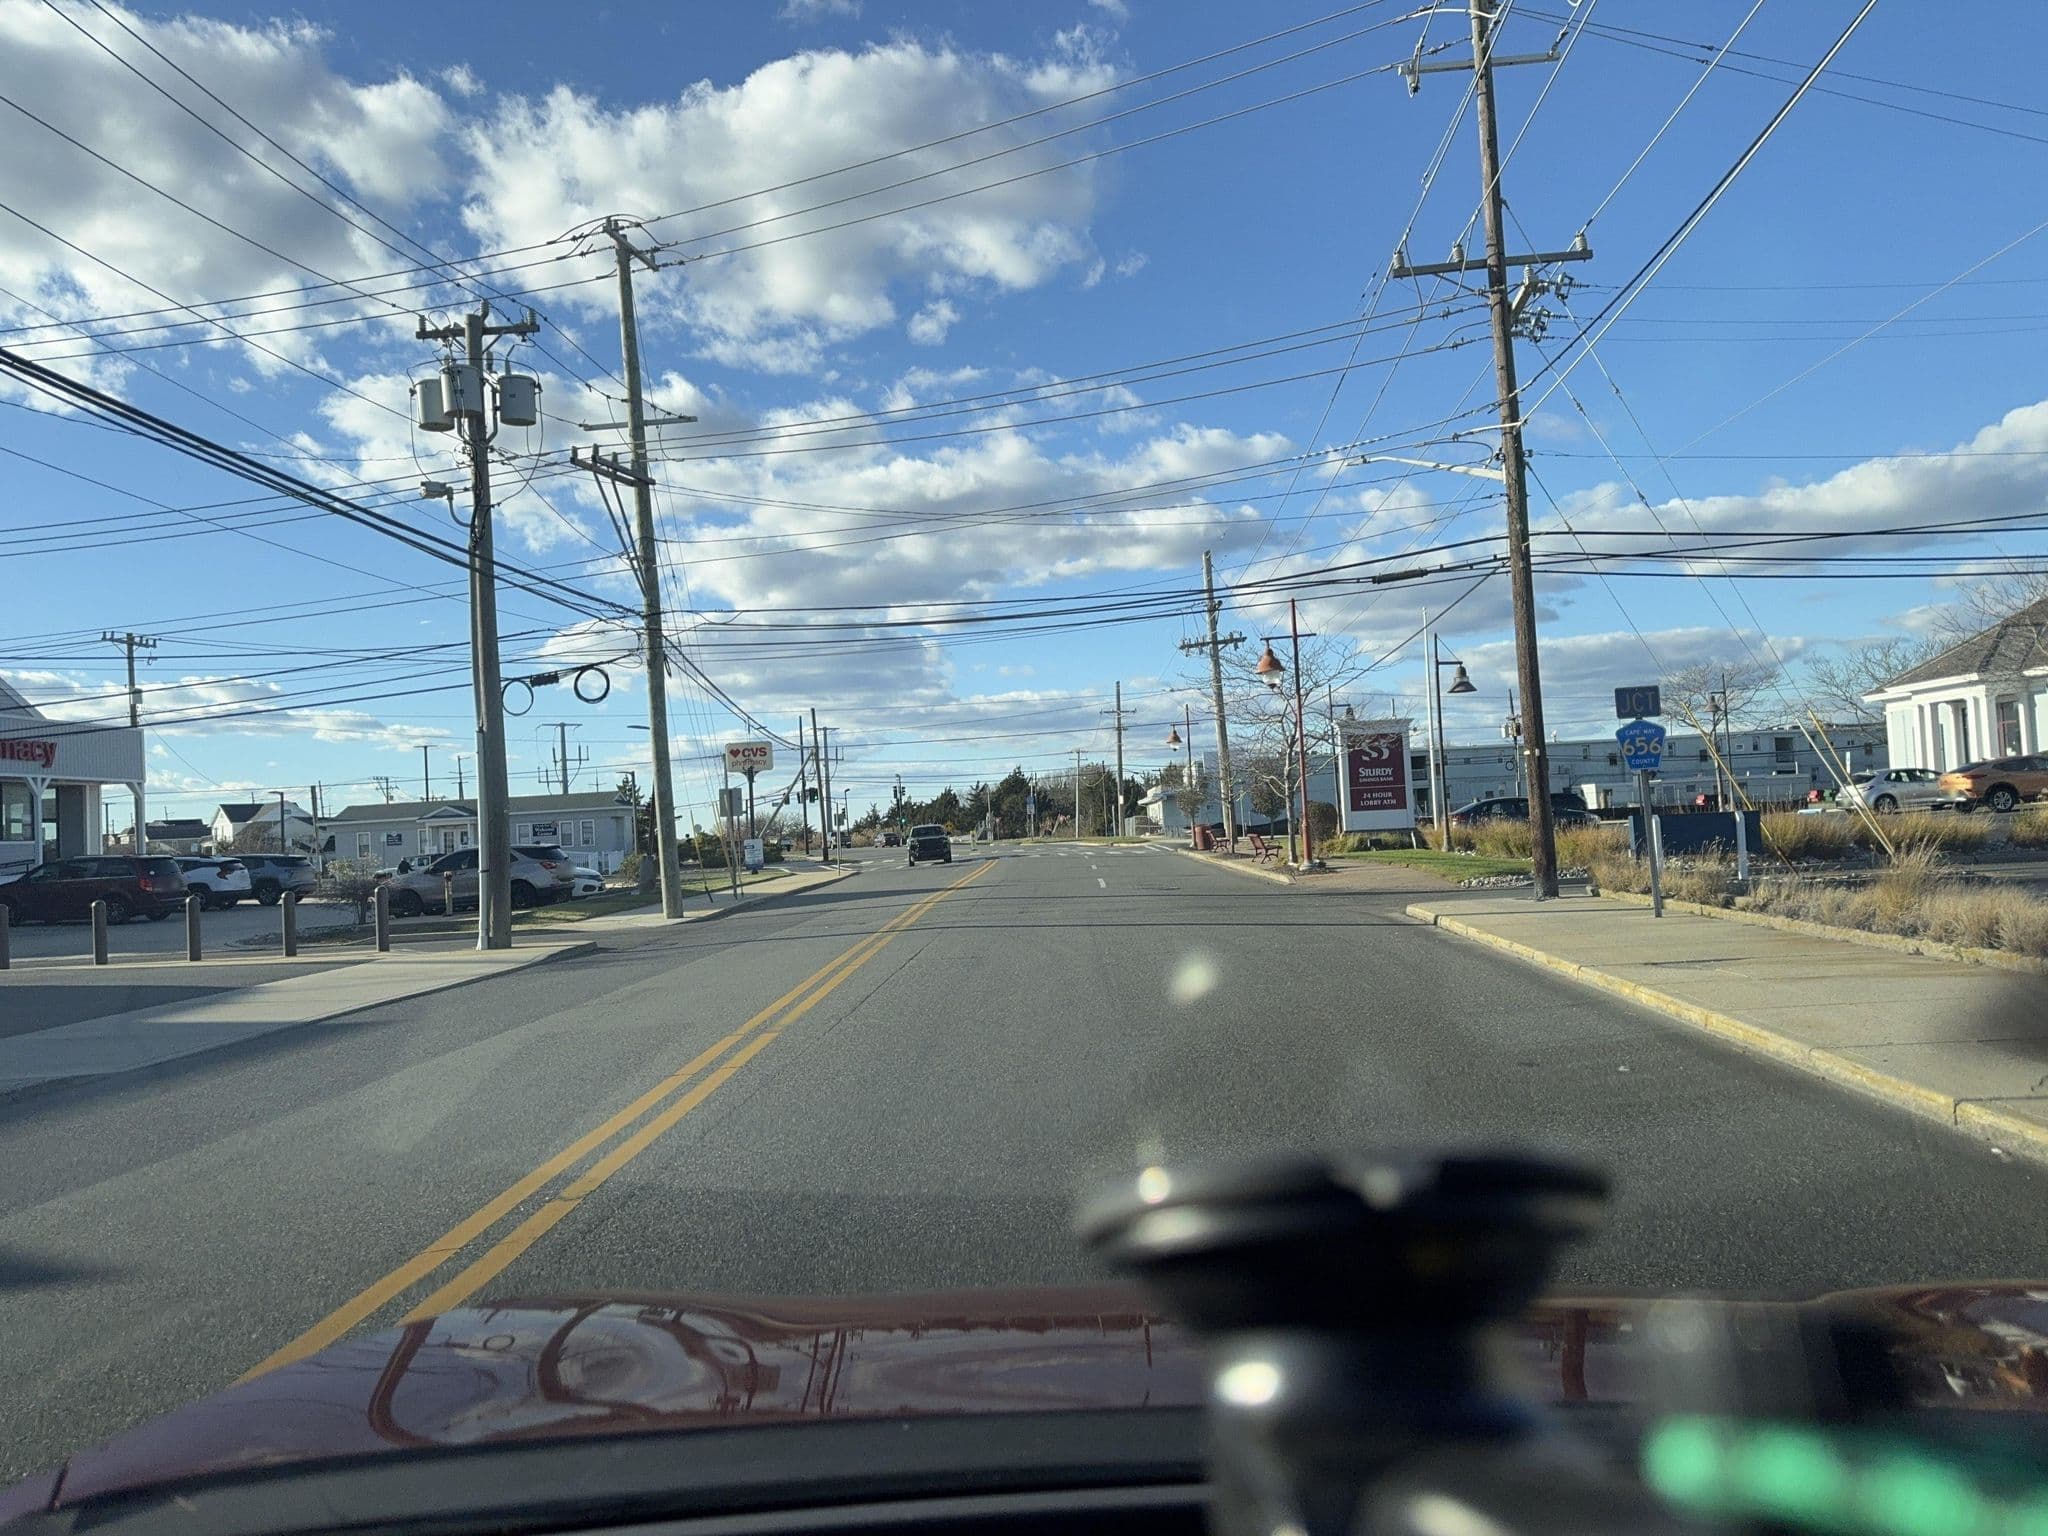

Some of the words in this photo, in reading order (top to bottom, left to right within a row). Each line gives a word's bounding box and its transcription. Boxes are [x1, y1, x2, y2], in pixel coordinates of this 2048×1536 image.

[1620, 691, 1655, 713] JCT
[742, 747, 767, 757] CVS
[1623, 736, 1661, 756] 656
[1359, 767, 1393, 776] STURDY
